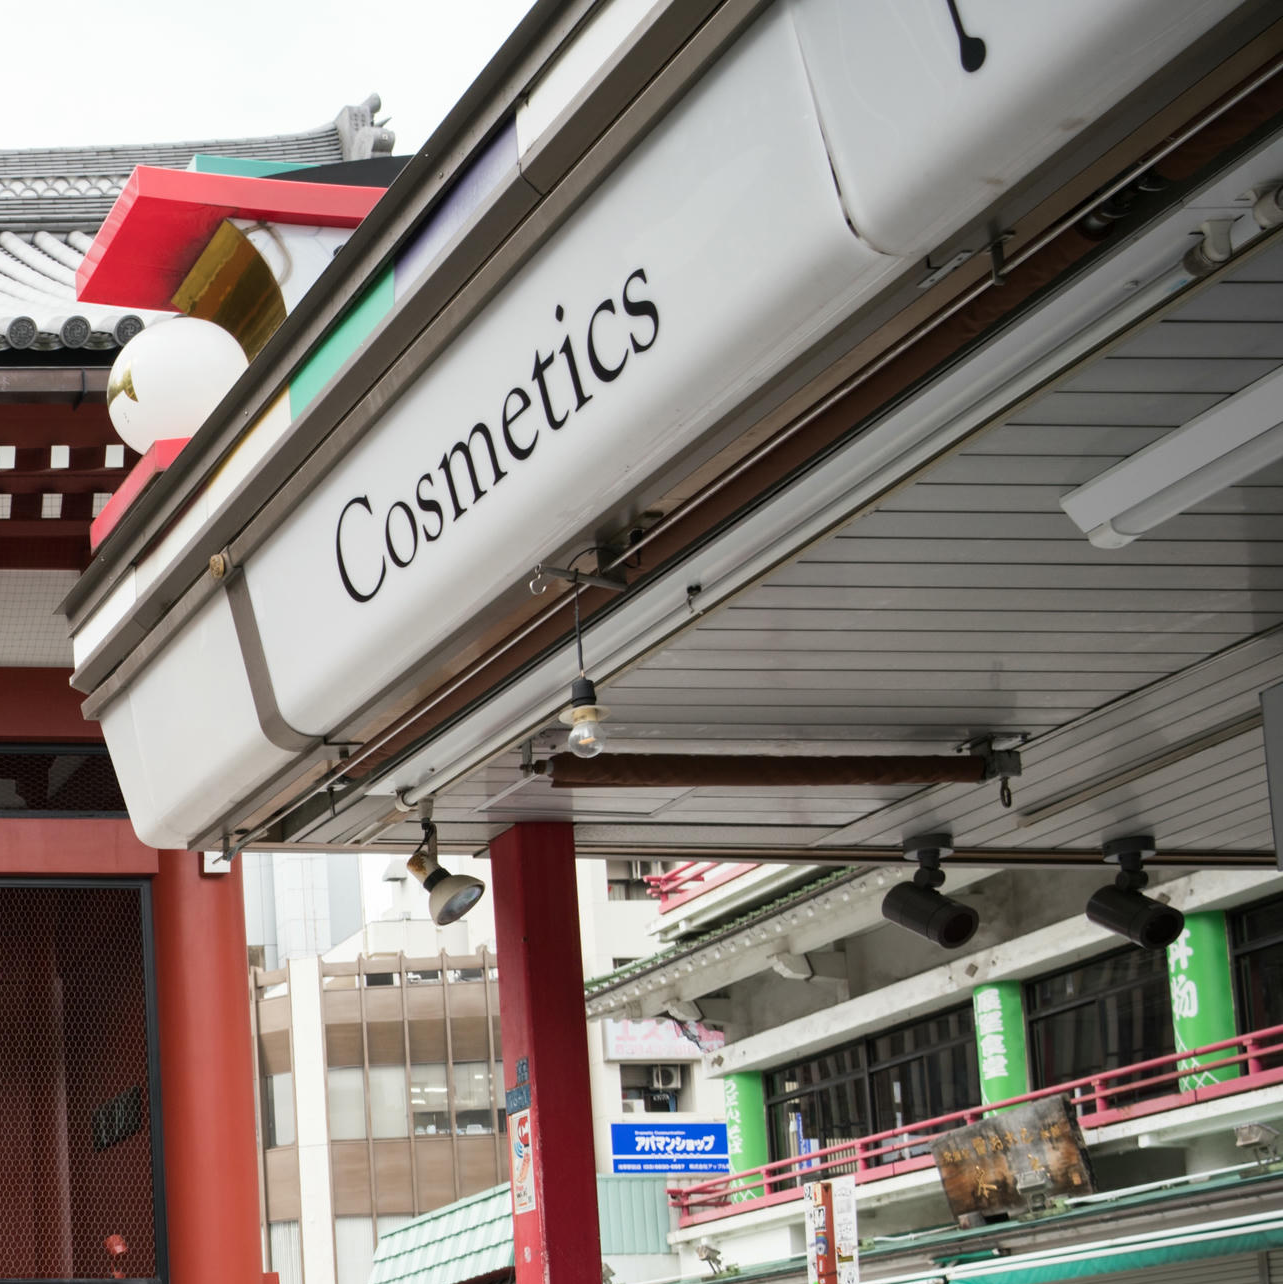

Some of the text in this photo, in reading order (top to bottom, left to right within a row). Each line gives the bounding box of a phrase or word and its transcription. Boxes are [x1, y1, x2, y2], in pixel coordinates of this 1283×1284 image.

[332, 267, 662, 604] Cosmetics
[635, 1135, 715, 1152] アパマンショップ
